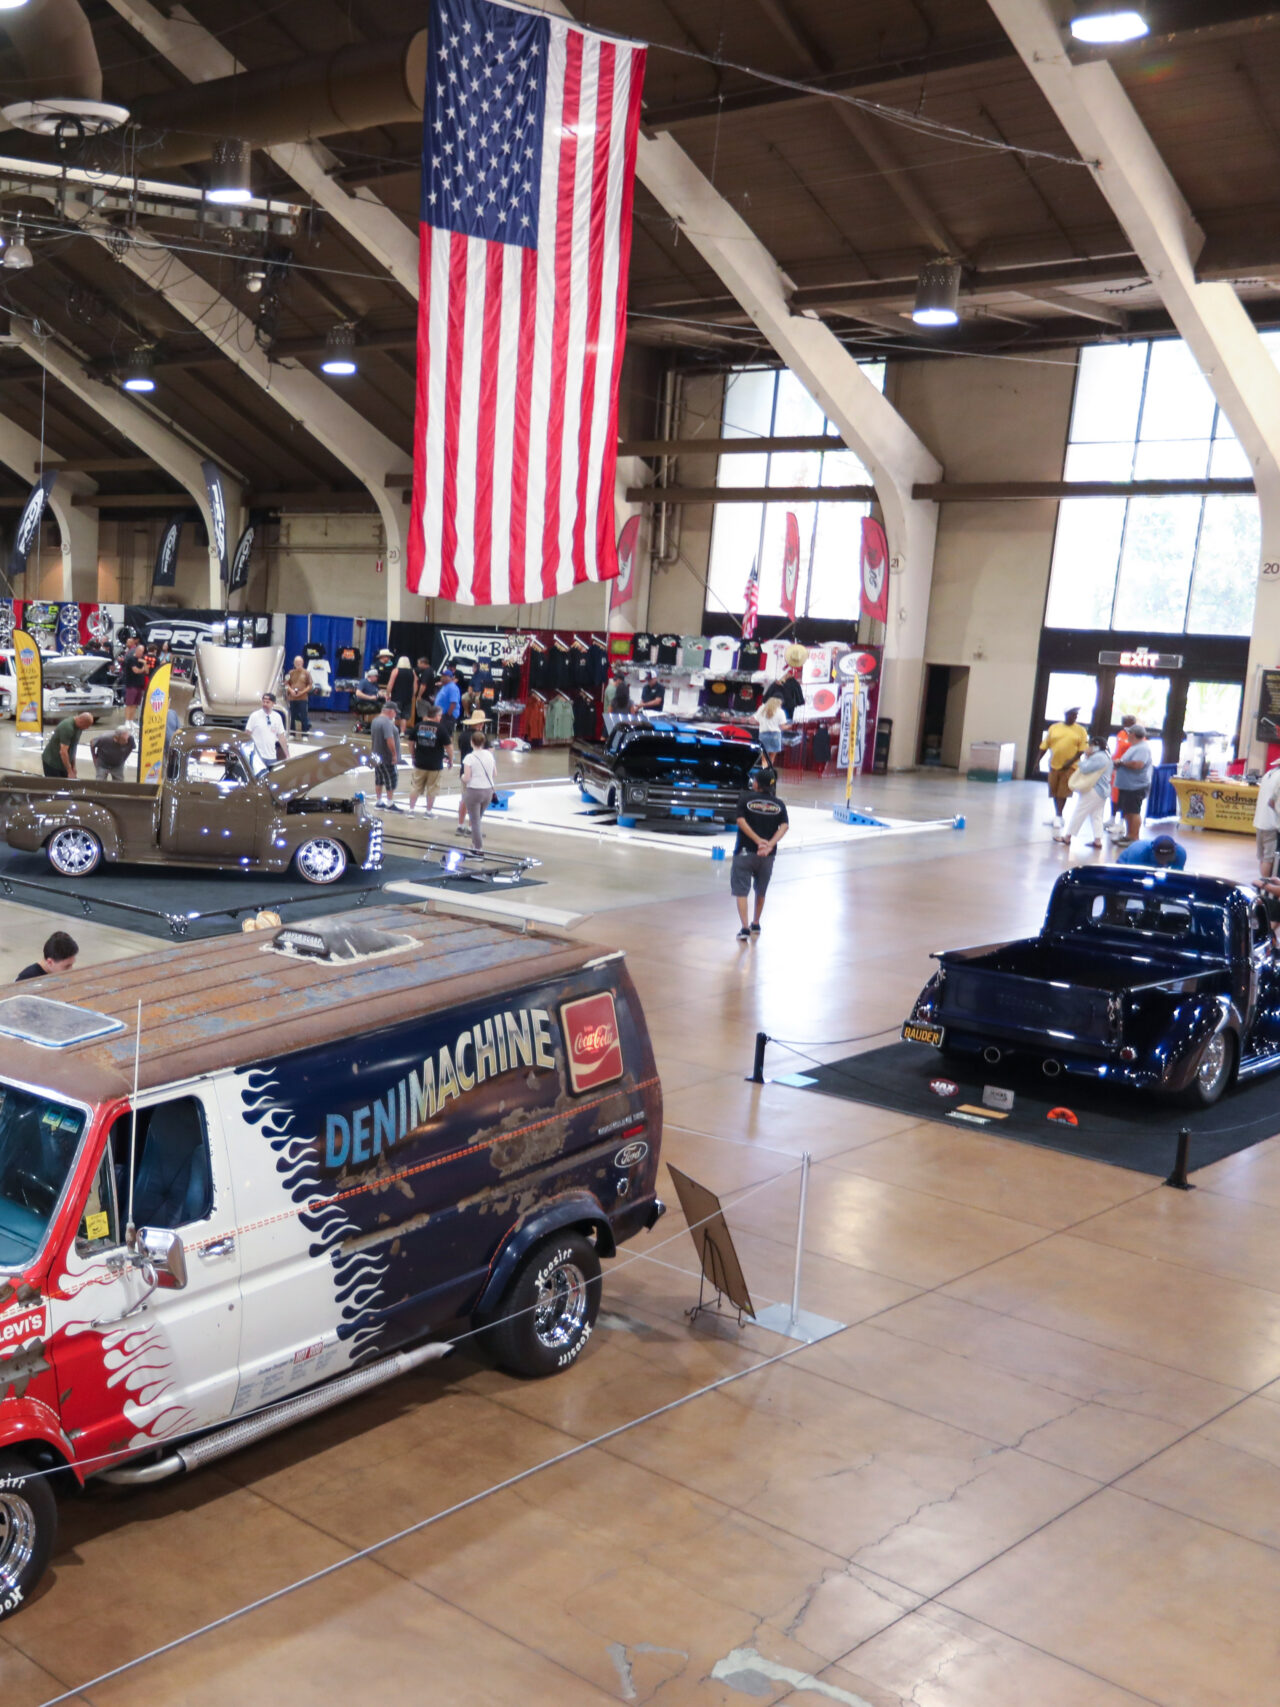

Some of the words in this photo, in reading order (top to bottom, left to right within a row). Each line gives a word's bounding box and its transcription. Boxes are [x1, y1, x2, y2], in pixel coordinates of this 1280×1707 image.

[1263, 562, 1280, 575] 20
[1120, 652, 1160, 668] EXIT
[904, 1026, 940, 1044] BAUDER
[325, 1008, 556, 1168] DENIMACHINE
[930, 1081, 956, 1092] JAX
[621, 1144, 642, 1165] Ford
